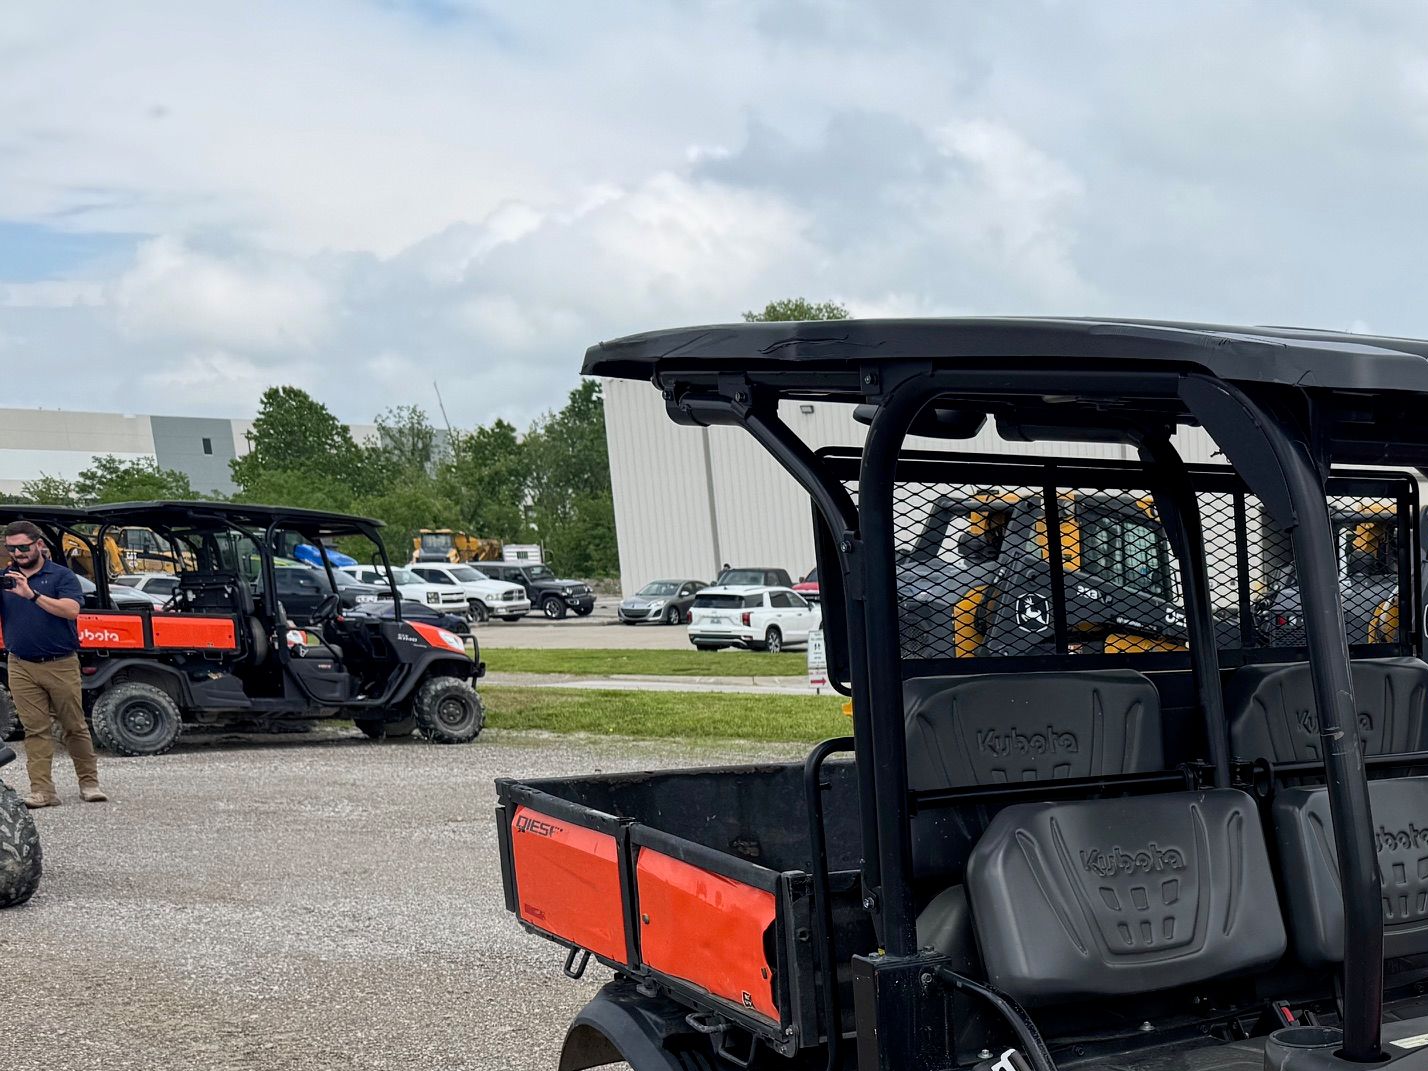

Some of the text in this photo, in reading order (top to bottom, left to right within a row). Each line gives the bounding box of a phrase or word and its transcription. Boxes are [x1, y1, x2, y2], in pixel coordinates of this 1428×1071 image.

[78, 629, 120, 642] ubota
[976, 725, 1079, 757] Kubota
[516, 815, 558, 838] DIES
[1078, 841, 1187, 877] Kubota
